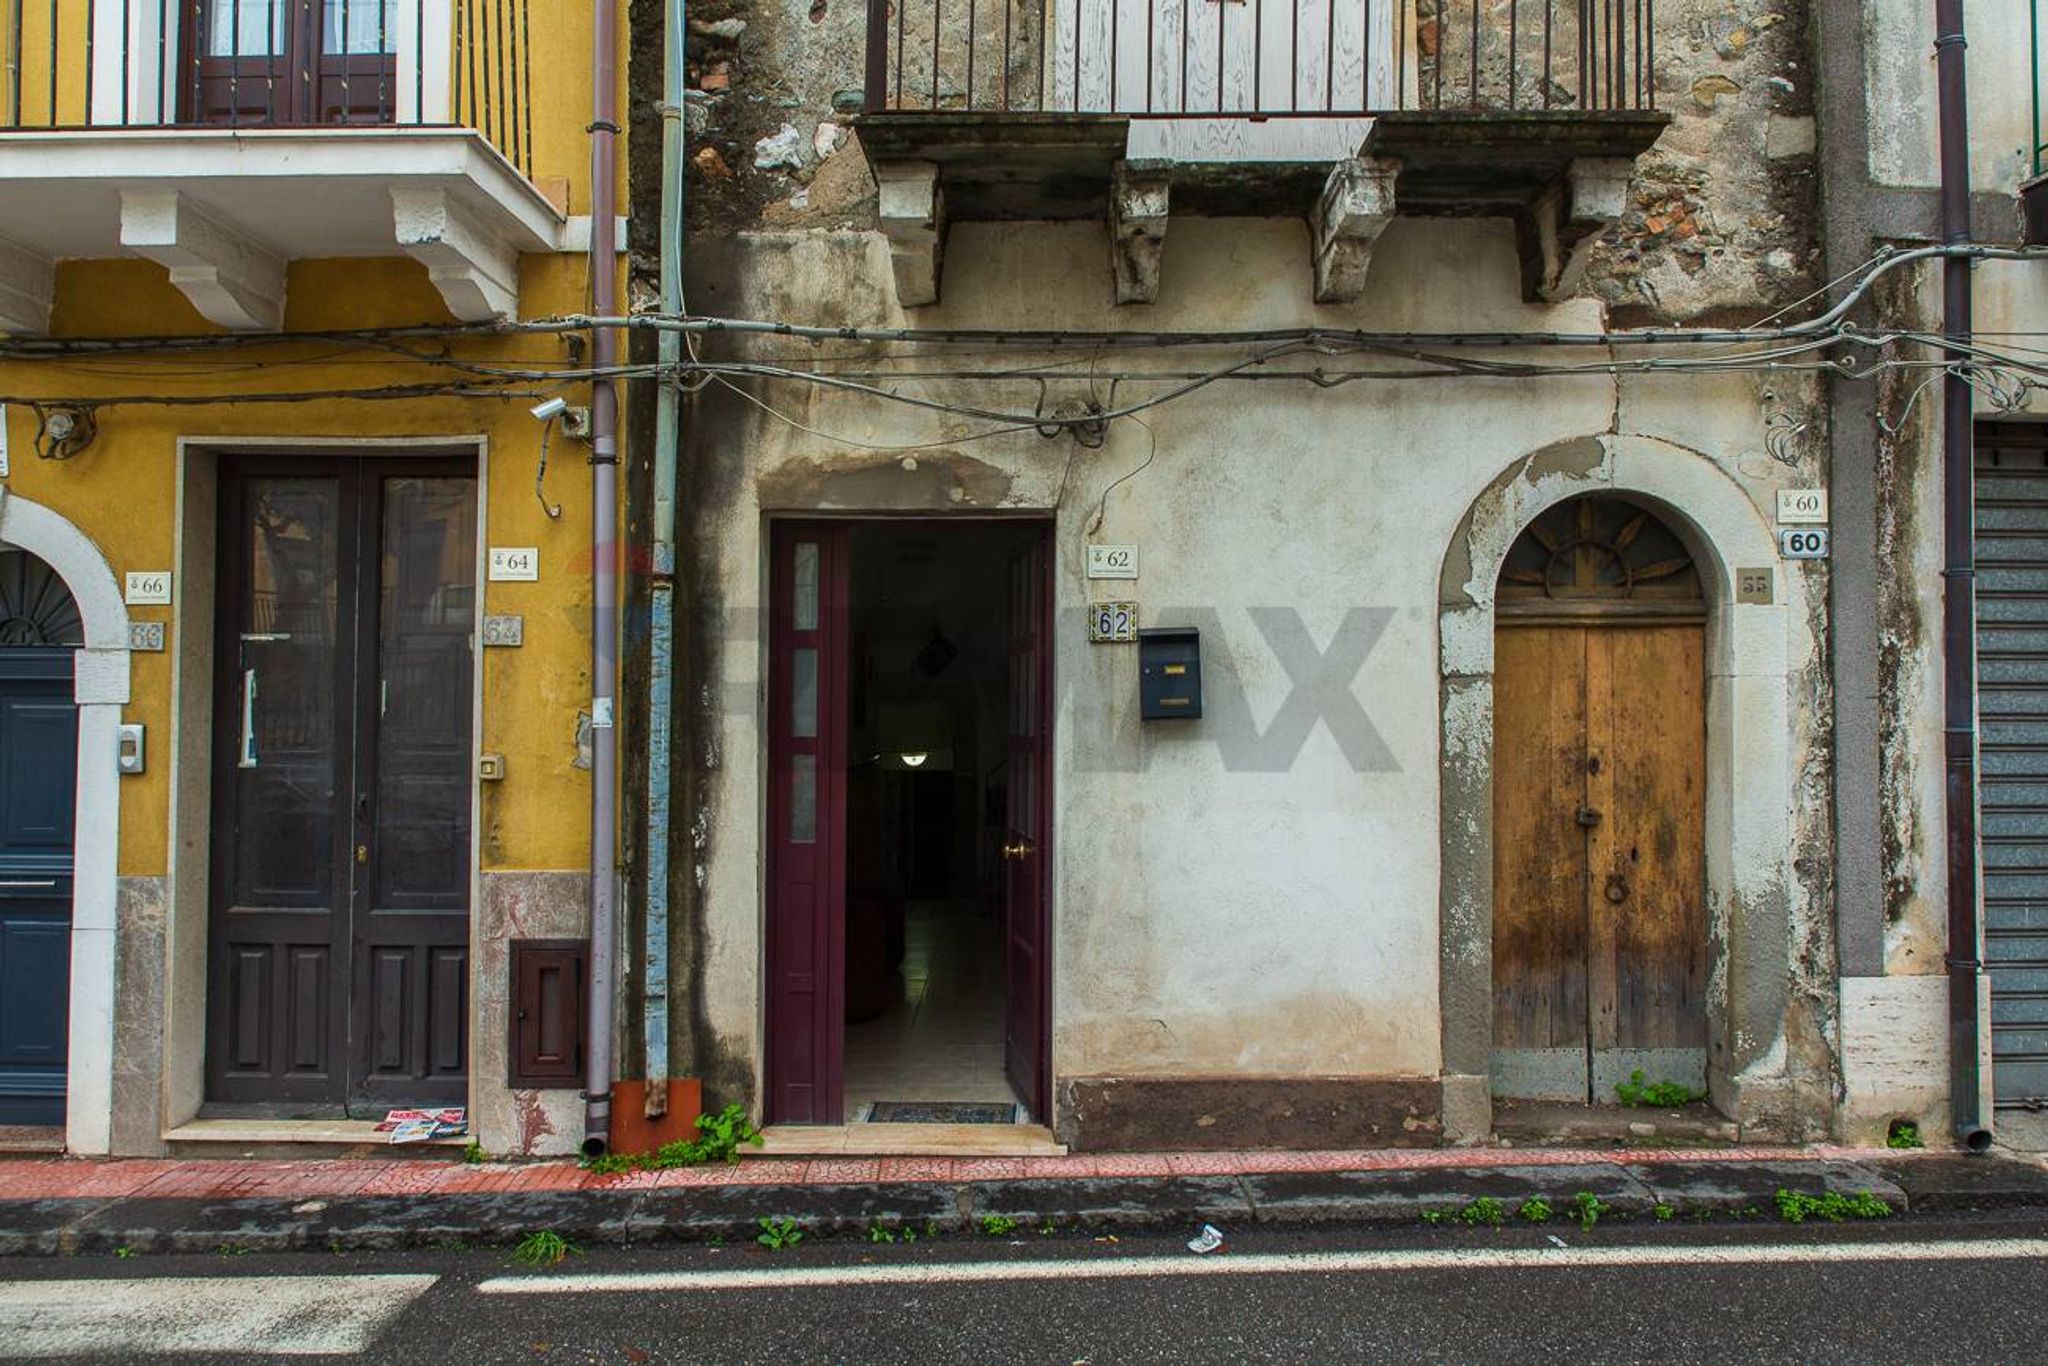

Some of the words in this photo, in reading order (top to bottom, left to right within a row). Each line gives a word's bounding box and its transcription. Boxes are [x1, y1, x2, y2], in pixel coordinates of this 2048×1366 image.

[1796, 495, 1819, 512] 60
[1790, 532, 1821, 553] 60
[507, 554, 529, 570] 64
[1107, 550, 1129, 568] 62
[142, 577, 163, 594] 66
[1099, 611, 1129, 635] 62
